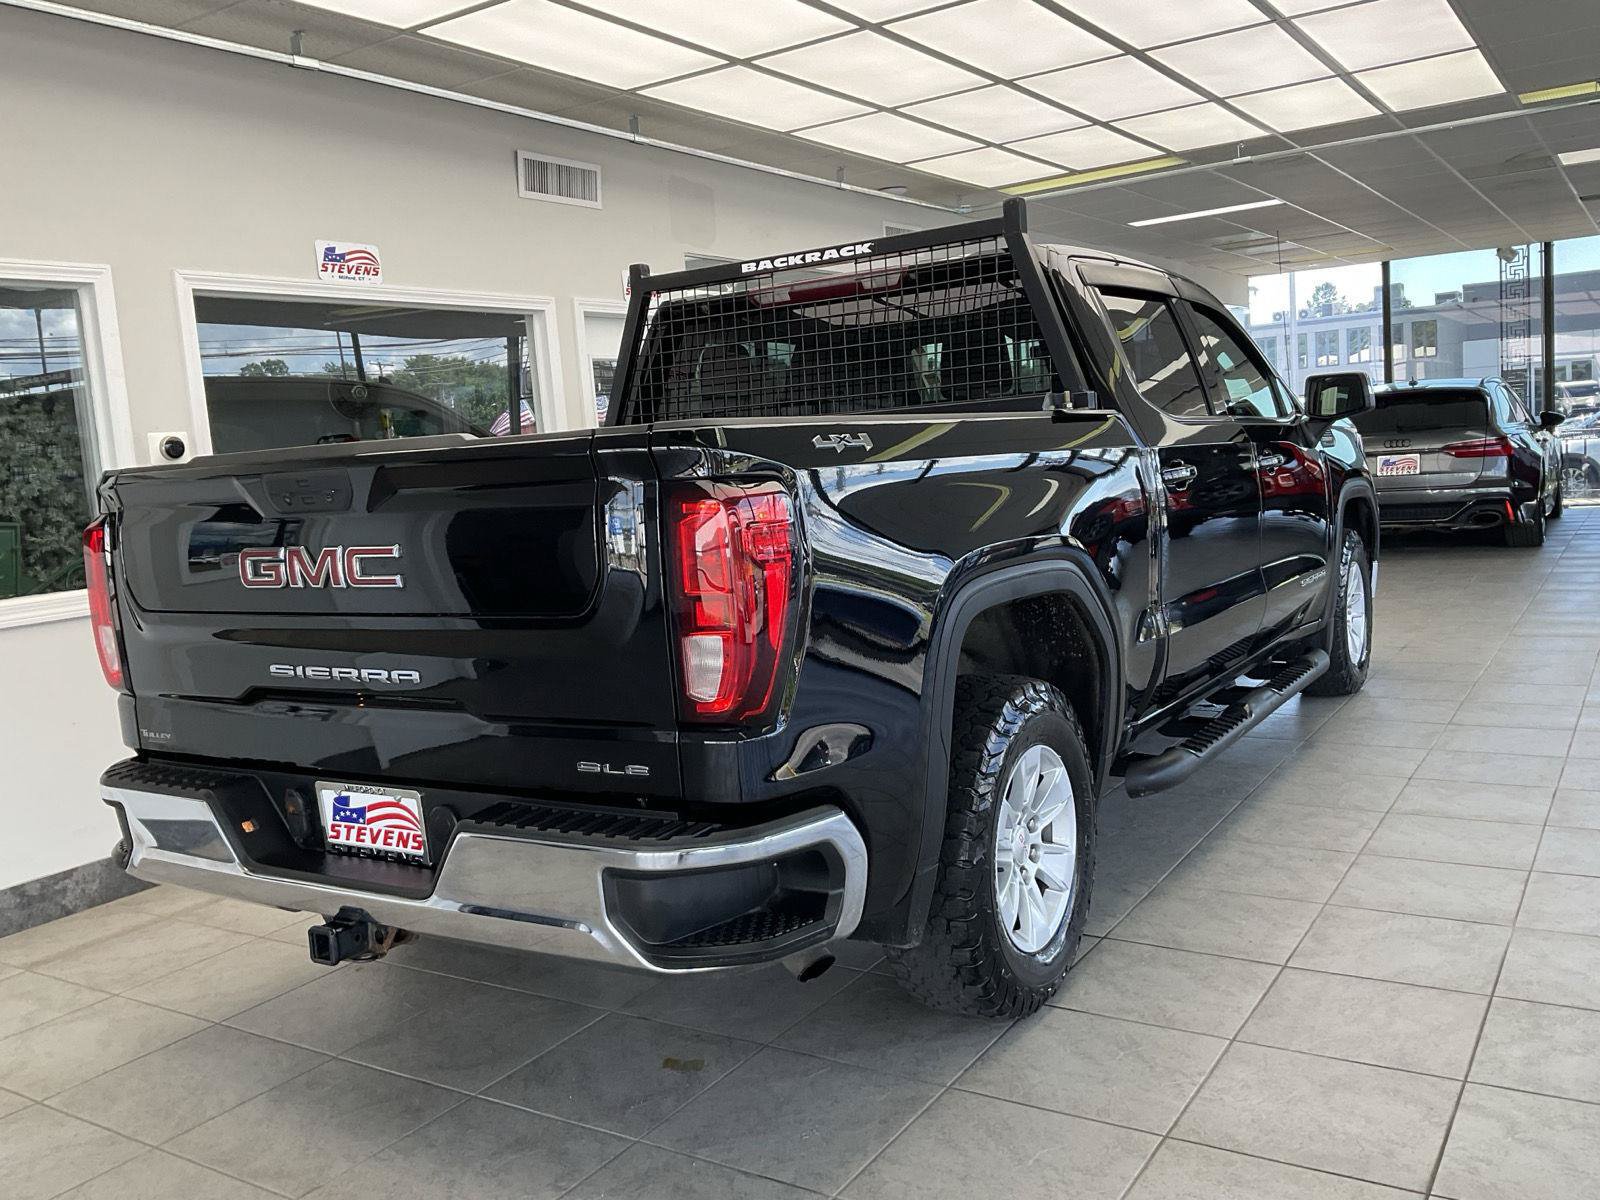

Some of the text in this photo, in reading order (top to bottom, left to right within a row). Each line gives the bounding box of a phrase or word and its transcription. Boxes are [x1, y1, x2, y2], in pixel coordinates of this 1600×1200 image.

[320, 262, 380, 277] STEVENS
[741, 242, 873, 273] BACKRACK
[238, 544, 403, 589] GMC
[269, 664, 421, 684] SIERRA
[576, 761, 650, 776] SLE
[328, 823, 423, 851] STEVENS
